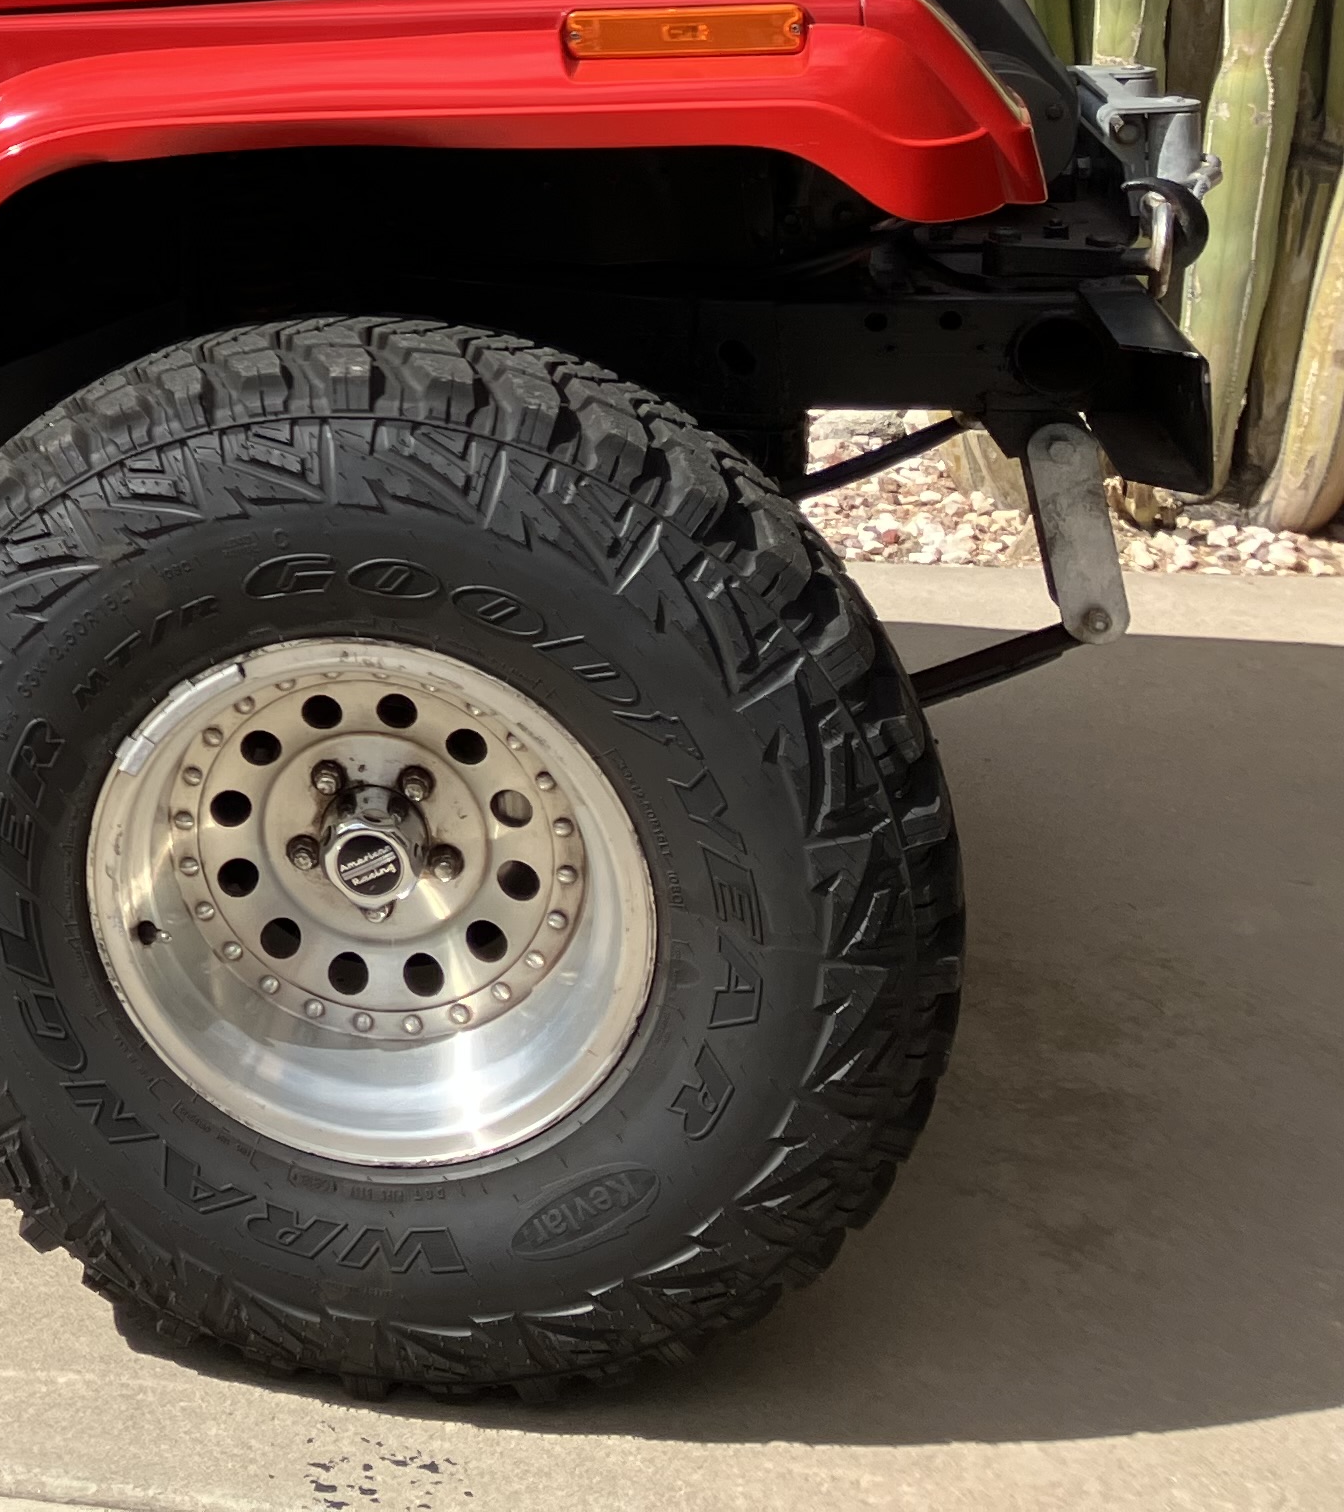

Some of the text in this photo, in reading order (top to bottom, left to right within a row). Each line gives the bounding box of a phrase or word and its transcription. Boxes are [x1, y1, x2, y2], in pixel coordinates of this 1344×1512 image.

[72, 593, 221, 712] MT/R
[242, 553, 764, 1142] GOODYEAR
[351, 863, 398, 886] Racing
[532, 1172, 640, 1245] Kevlar
